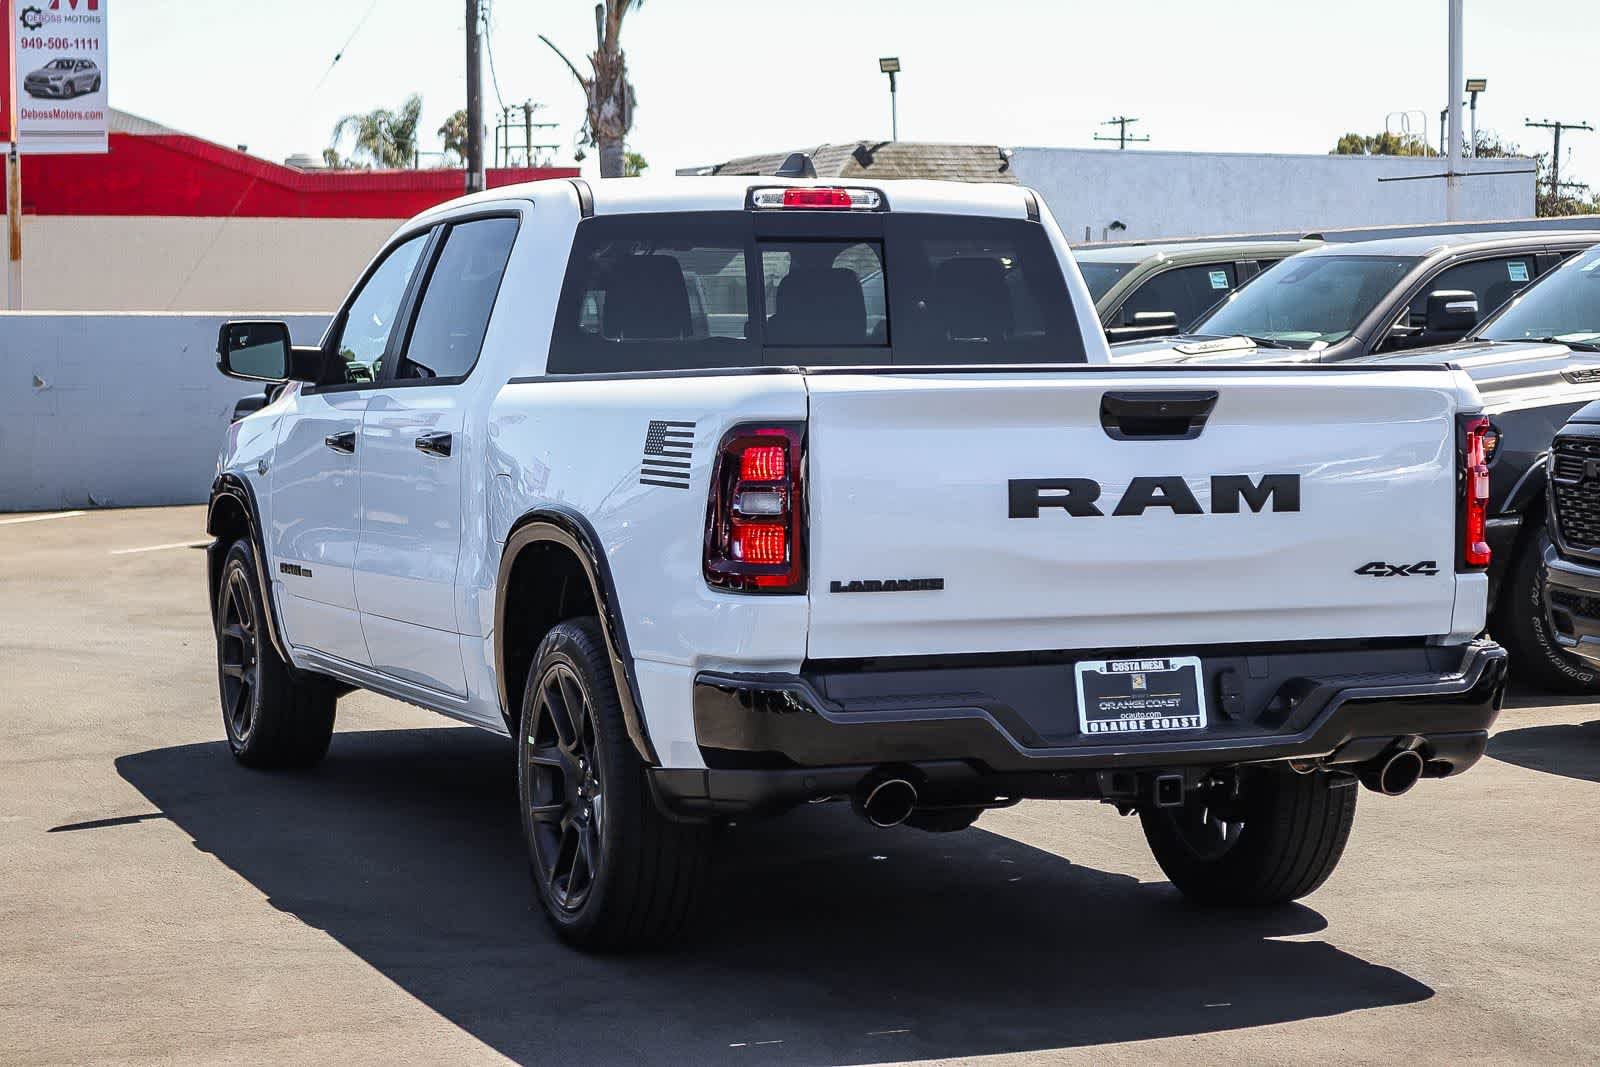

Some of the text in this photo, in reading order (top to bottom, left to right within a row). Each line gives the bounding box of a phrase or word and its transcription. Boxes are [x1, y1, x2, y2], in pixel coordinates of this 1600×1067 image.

[64, 15, 101, 23] MOTORS
[21, 37, 99, 50] 949-506-1111
[21, 108, 104, 120] DebossMotors.com
[1008, 474, 1301, 519] RAM
[1353, 560, 1440, 577] 4x4
[1112, 660, 1164, 672] COSTA MESA
[1098, 698, 1182, 710] ORANGE COAST
[1120, 711, 1162, 720] ocauto.com
[1090, 717, 1198, 732] ORANGE COAST
